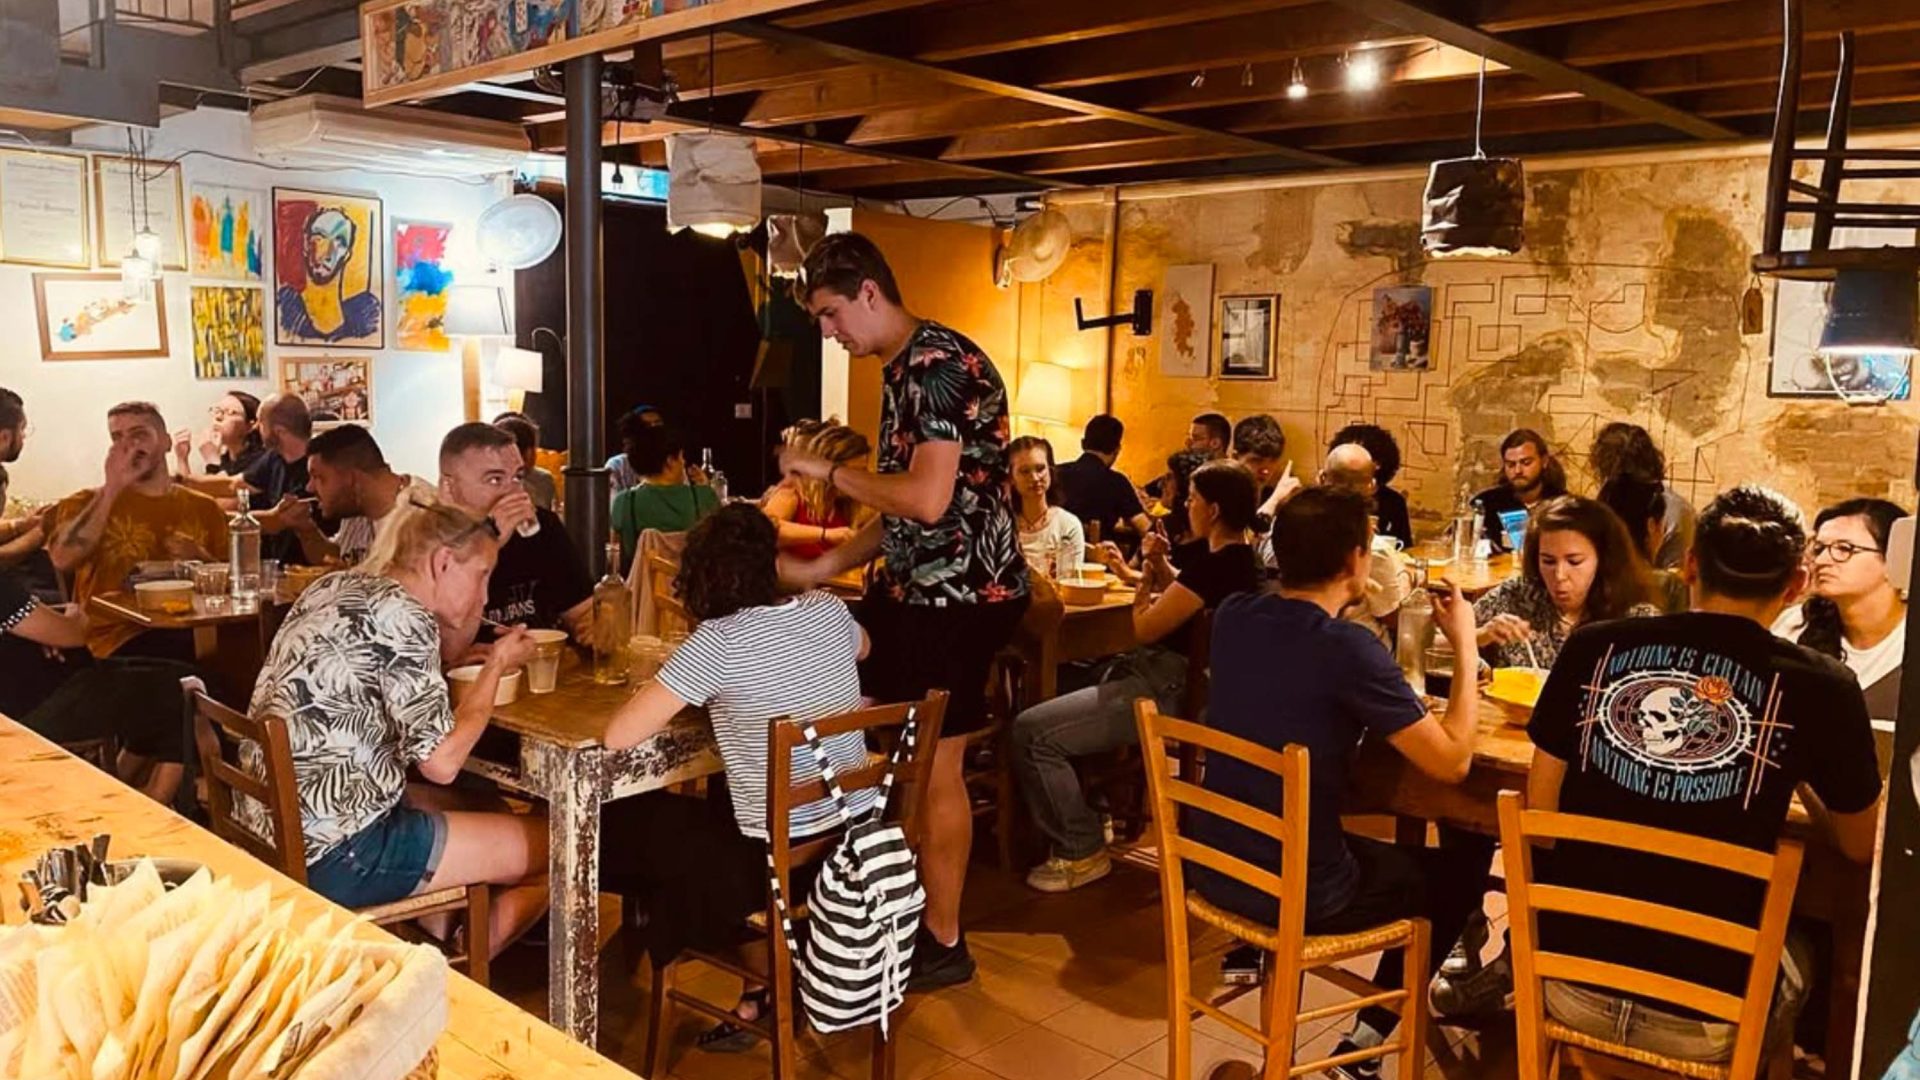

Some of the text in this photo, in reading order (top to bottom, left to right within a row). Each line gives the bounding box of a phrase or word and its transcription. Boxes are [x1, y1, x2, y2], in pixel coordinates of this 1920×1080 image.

[1608, 644, 1767, 708] NOTHING IS CERTAIN
[1589, 735, 1748, 803] ANYTHING IS POSSIBLE
